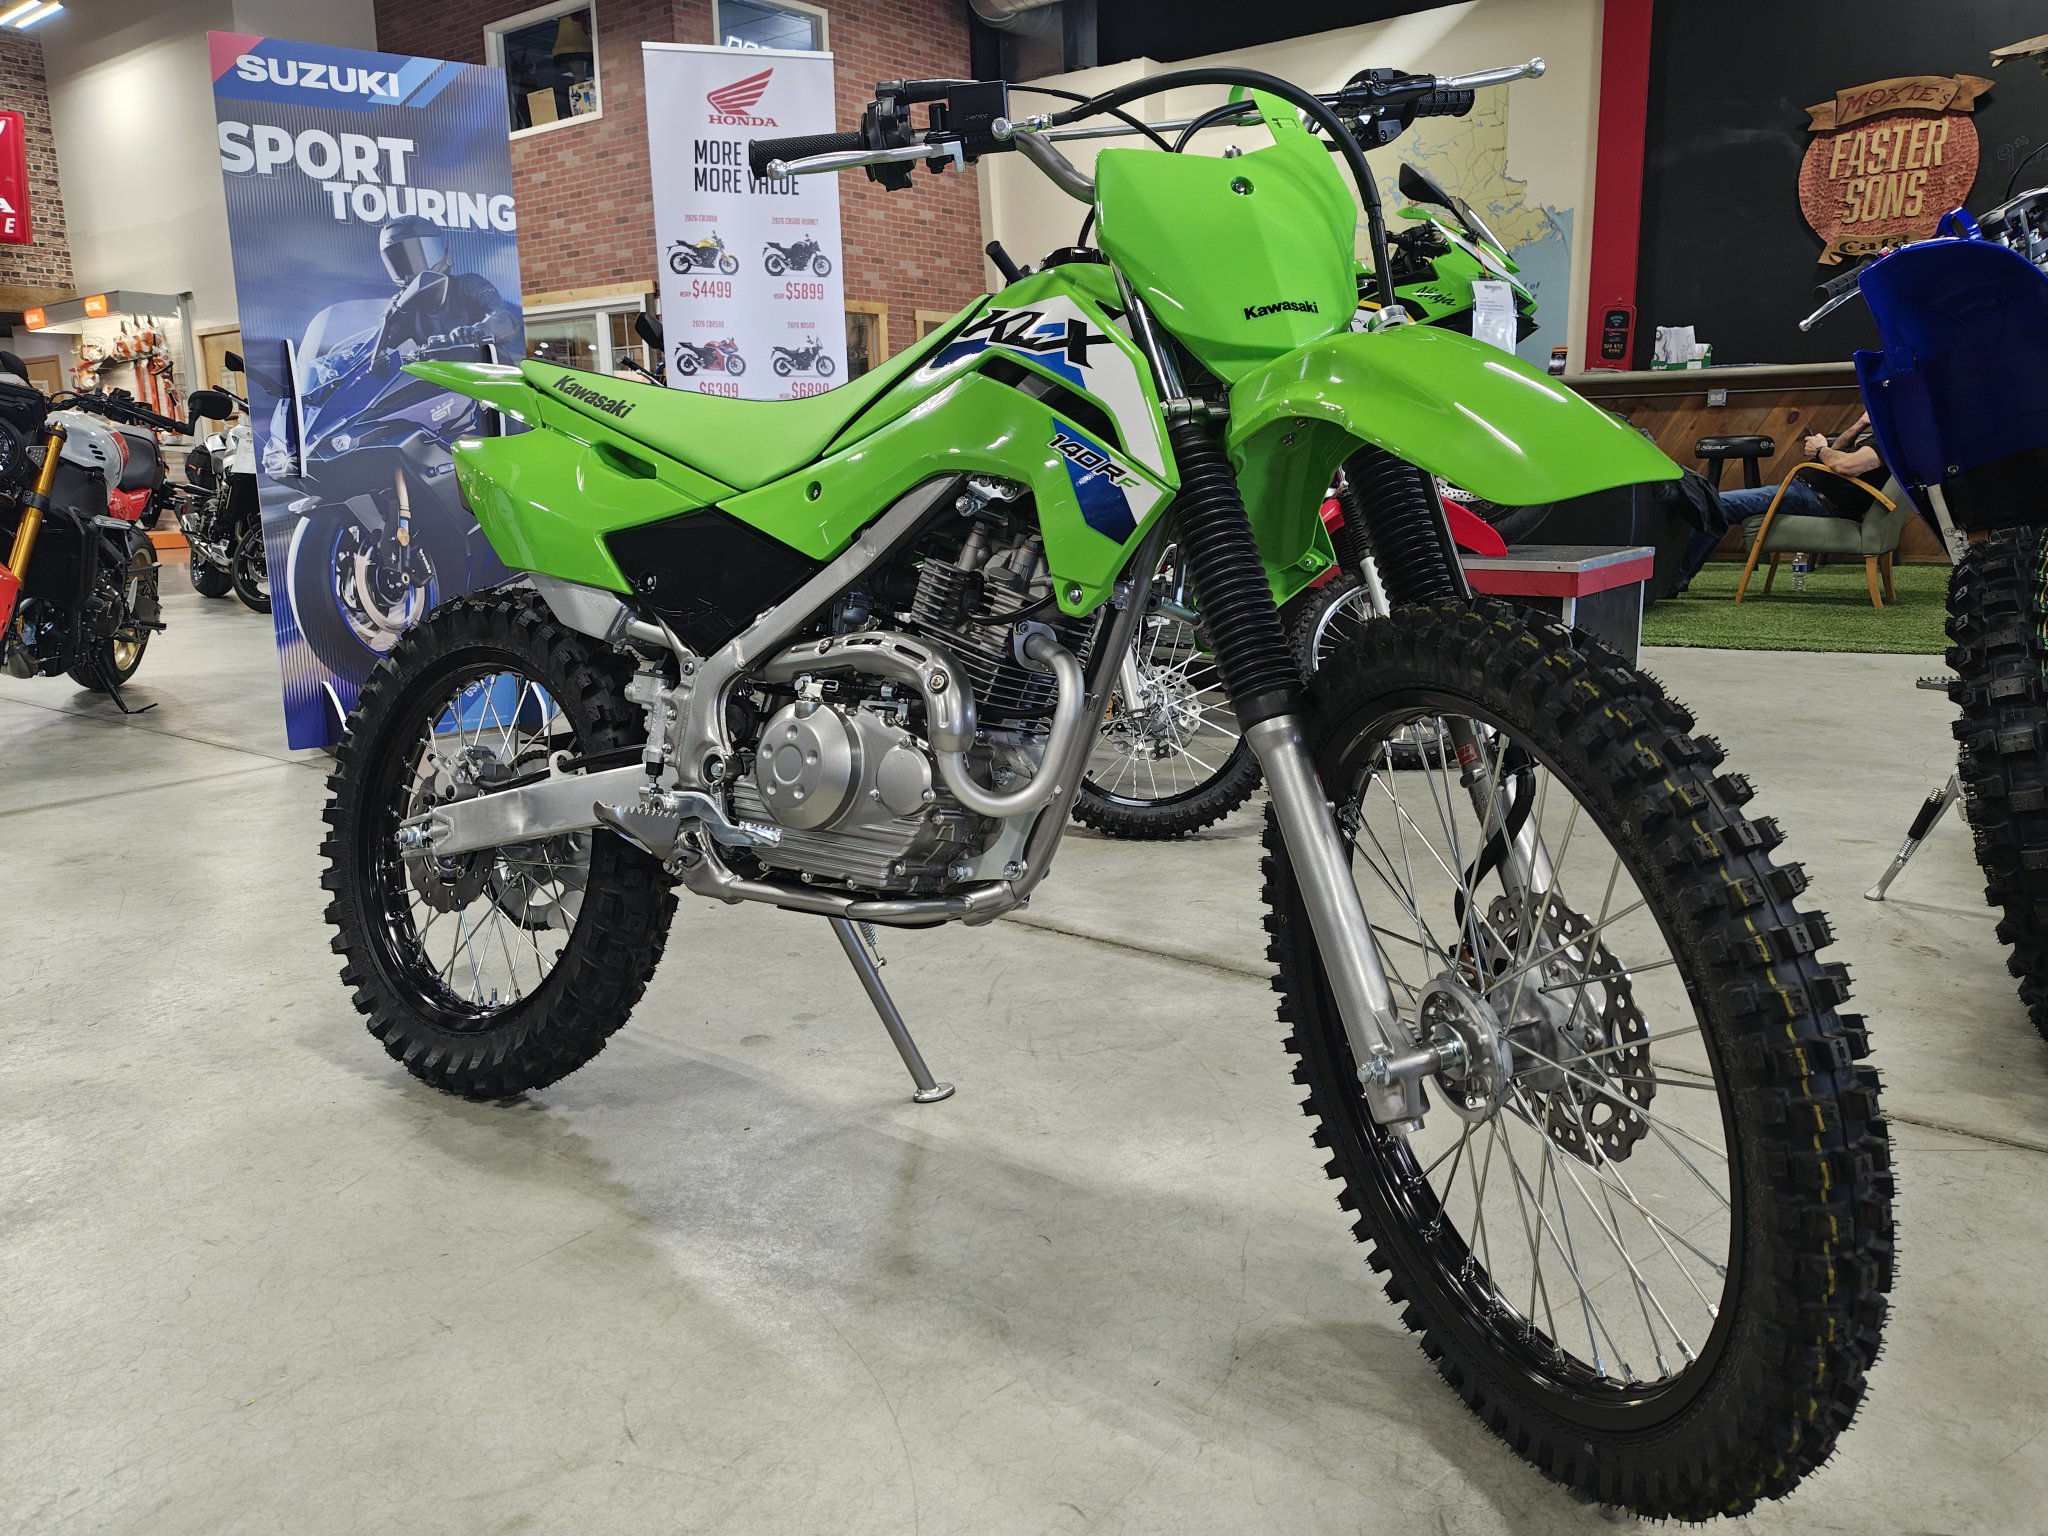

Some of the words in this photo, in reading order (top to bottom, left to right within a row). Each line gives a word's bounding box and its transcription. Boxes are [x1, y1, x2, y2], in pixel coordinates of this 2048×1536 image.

[236, 54, 400, 98] SUZUKI
[708, 115, 779, 127] HONDA
[217, 120, 414, 185] SPORT
[694, 139, 742, 166] MORE
[1829, 119, 1949, 181] FASTER
[694, 167, 742, 193] MORE
[322, 181, 518, 232] TOURING
[1842, 170, 1928, 224] SONS
[692, 279, 732, 298] $4499
[786, 281, 824, 300] $5899
[1415, 286, 1456, 306] Ninja
[1243, 300, 1319, 321] Kawasaki
[960, 309, 1116, 369] KLX
[552, 375, 636, 418] Kawasaki
[699, 381, 739, 398] $6399
[791, 380, 830, 399] $6899
